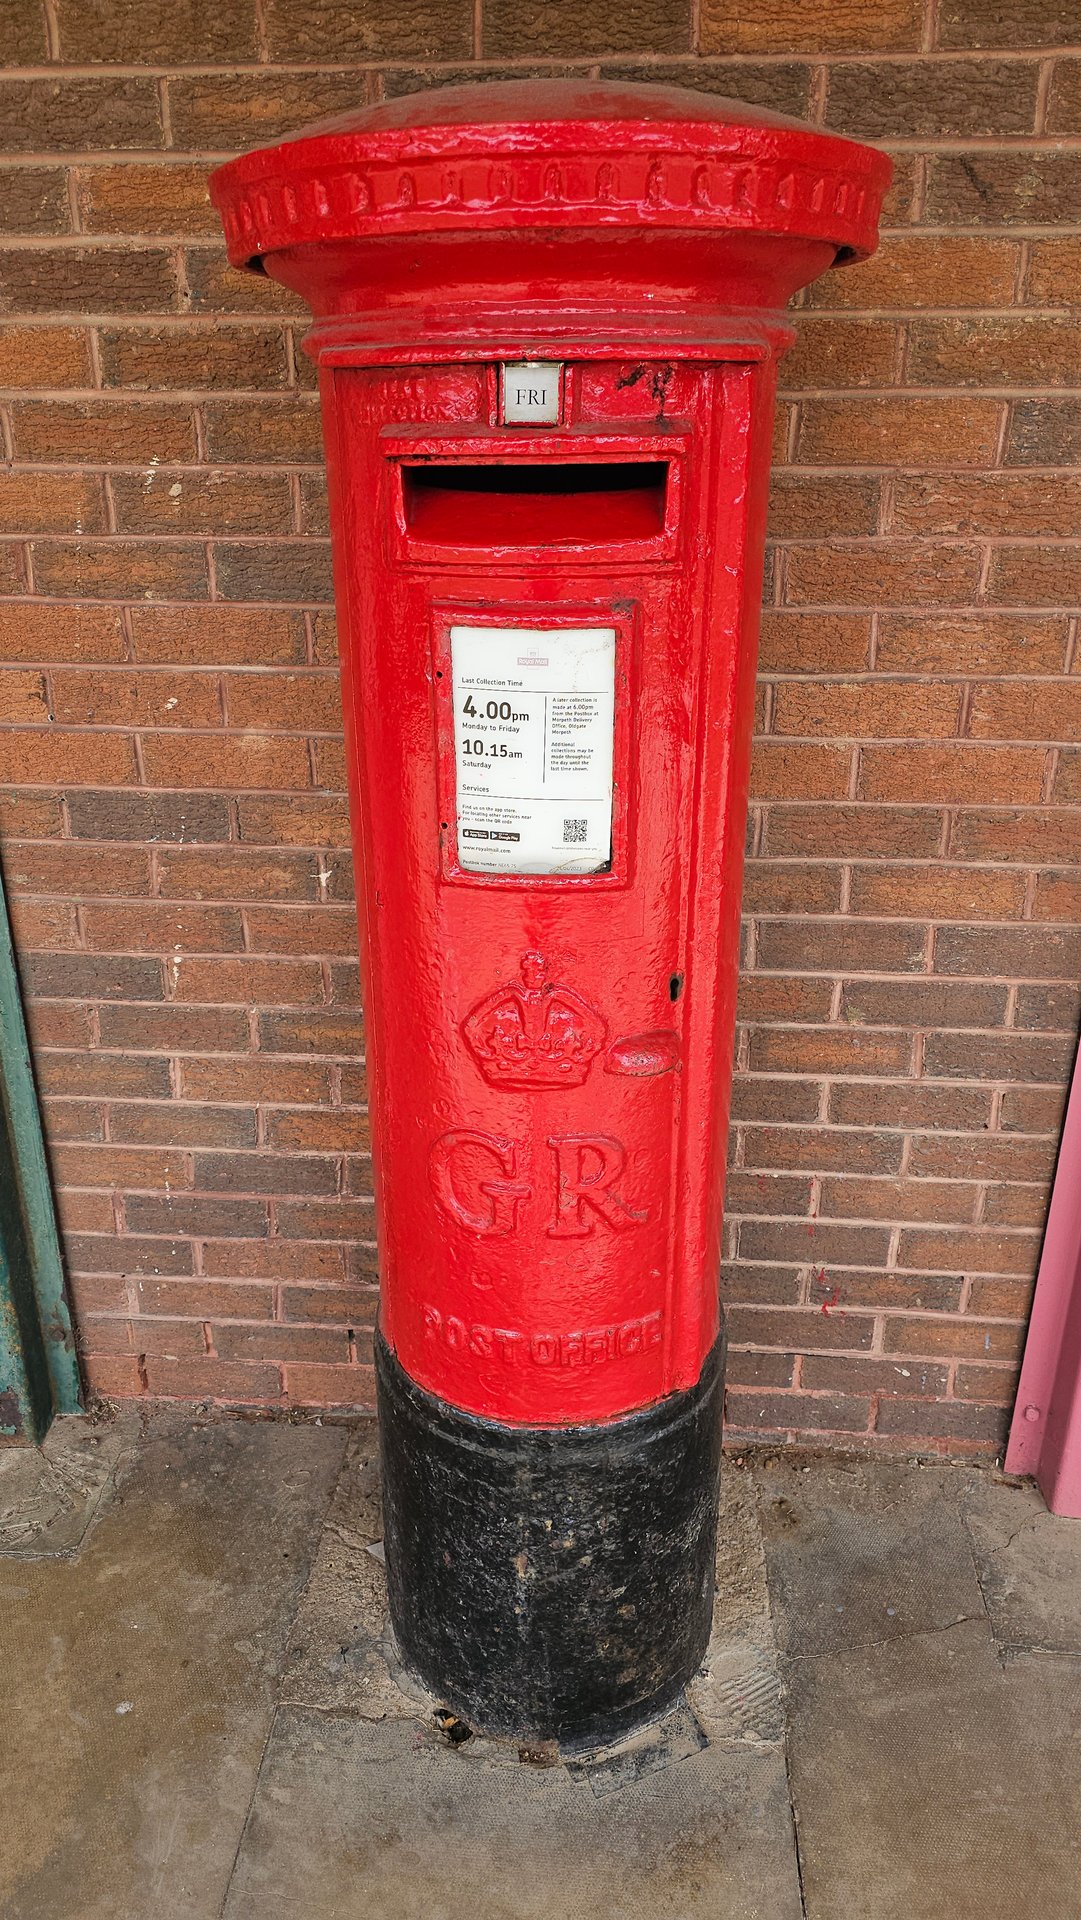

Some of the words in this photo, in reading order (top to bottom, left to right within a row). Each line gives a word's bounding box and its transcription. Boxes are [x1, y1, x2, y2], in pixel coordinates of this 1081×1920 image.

[515, 389, 547, 406] FRI
[476, 678, 506, 686] Collection
[462, 694, 530, 723] 4.00pm
[462, 722, 488, 732] Monday
[498, 725, 520, 734] Friday
[462, 738, 523, 759] 10.15am
[462, 760, 492, 770] Saturday
[462, 784, 490, 793] Services
[462, 846, 511, 854] www.royalmail.com
[420, 1303, 522, 1364] POST
[529, 1310, 663, 1367] OFFICE
